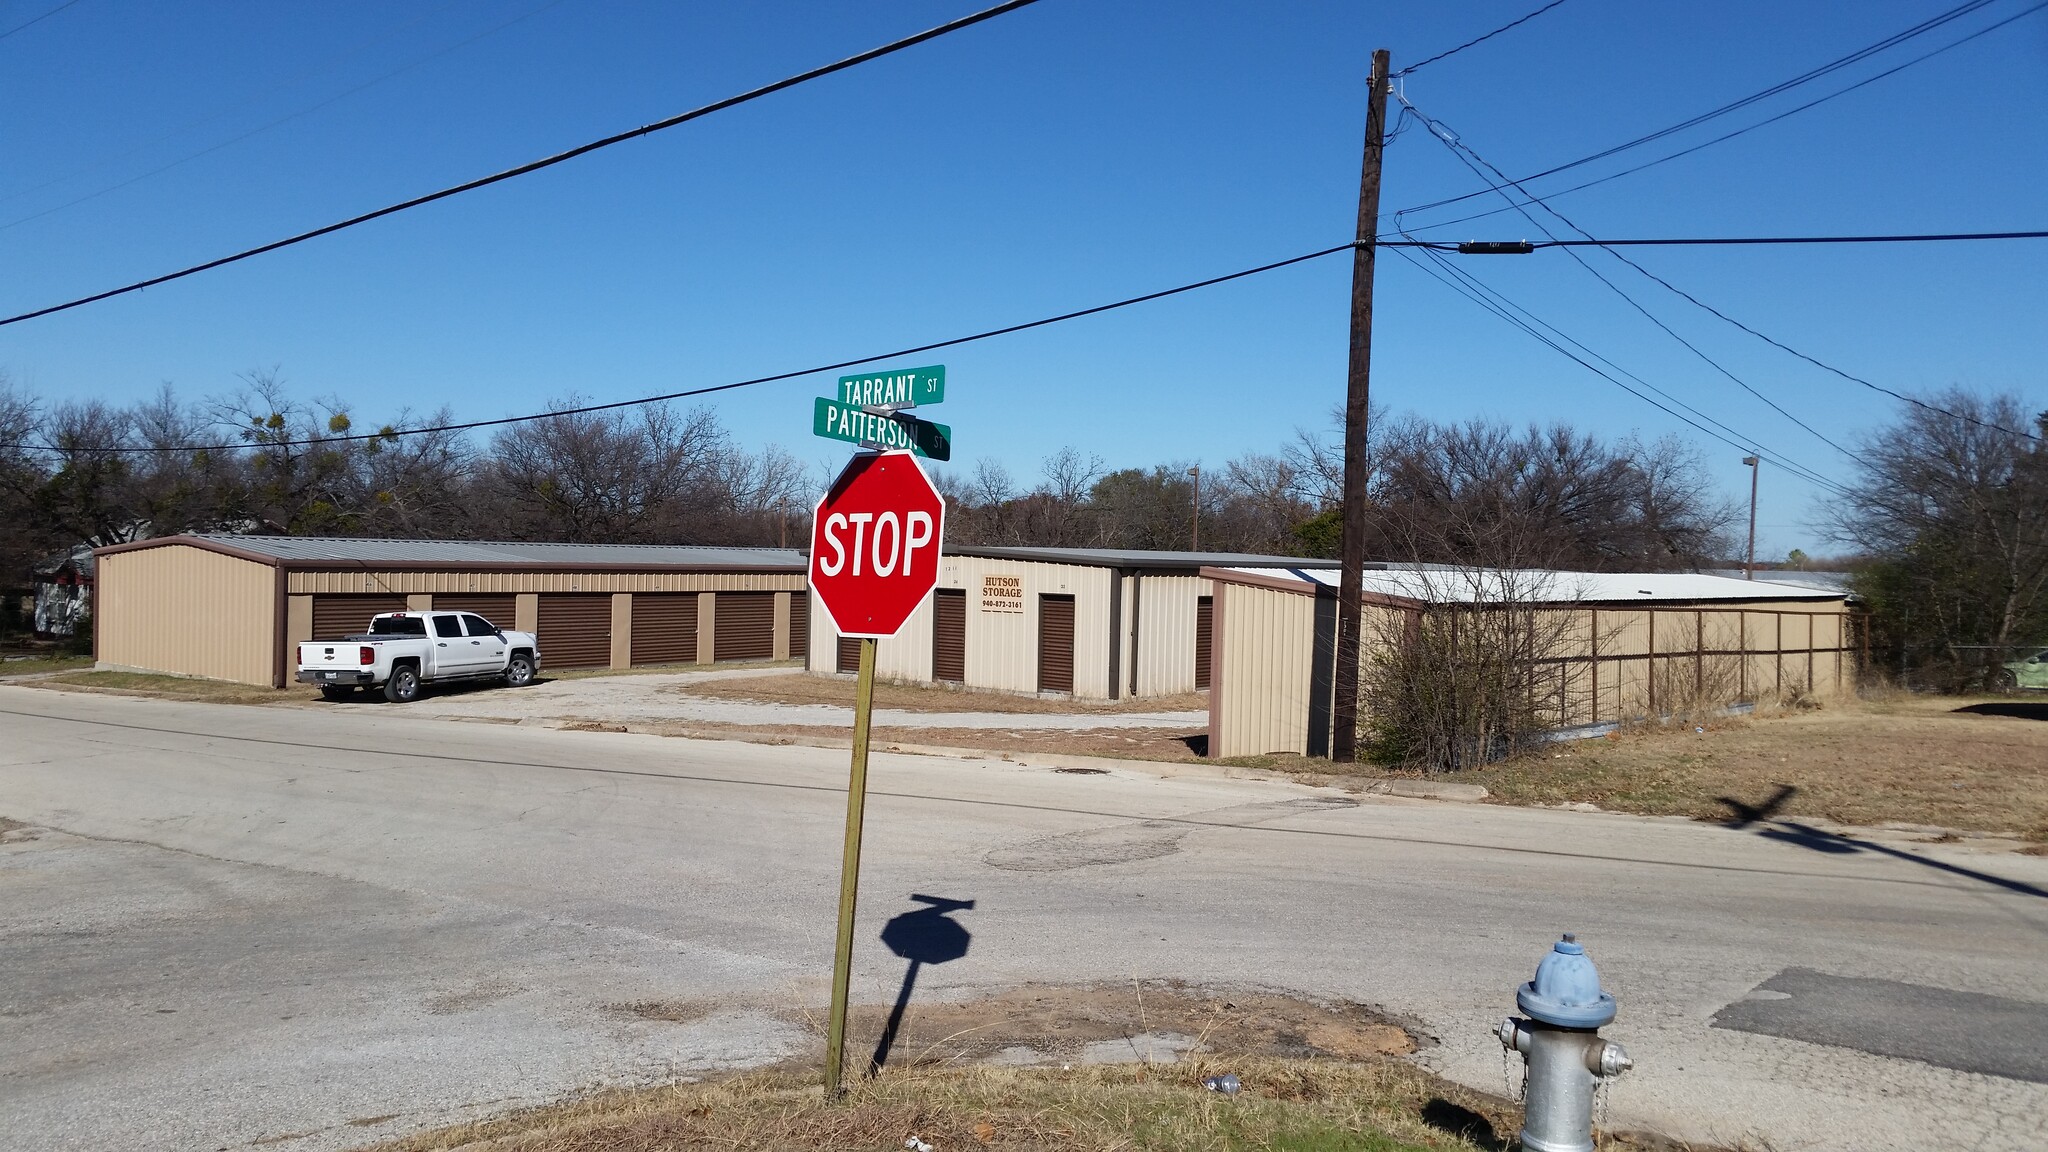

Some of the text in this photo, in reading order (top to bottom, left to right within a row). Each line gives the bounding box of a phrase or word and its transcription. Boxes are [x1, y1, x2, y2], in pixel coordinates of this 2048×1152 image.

[845, 374, 938, 405] TARRANT ST
[826, 405, 943, 450] PATTERSON ST
[819, 511, 933, 577] STOP
[982, 587, 1022, 598] STORAGE
[985, 577, 1020, 587] HUTSON
[982, 599, 1022, 609] 940-872-3161
